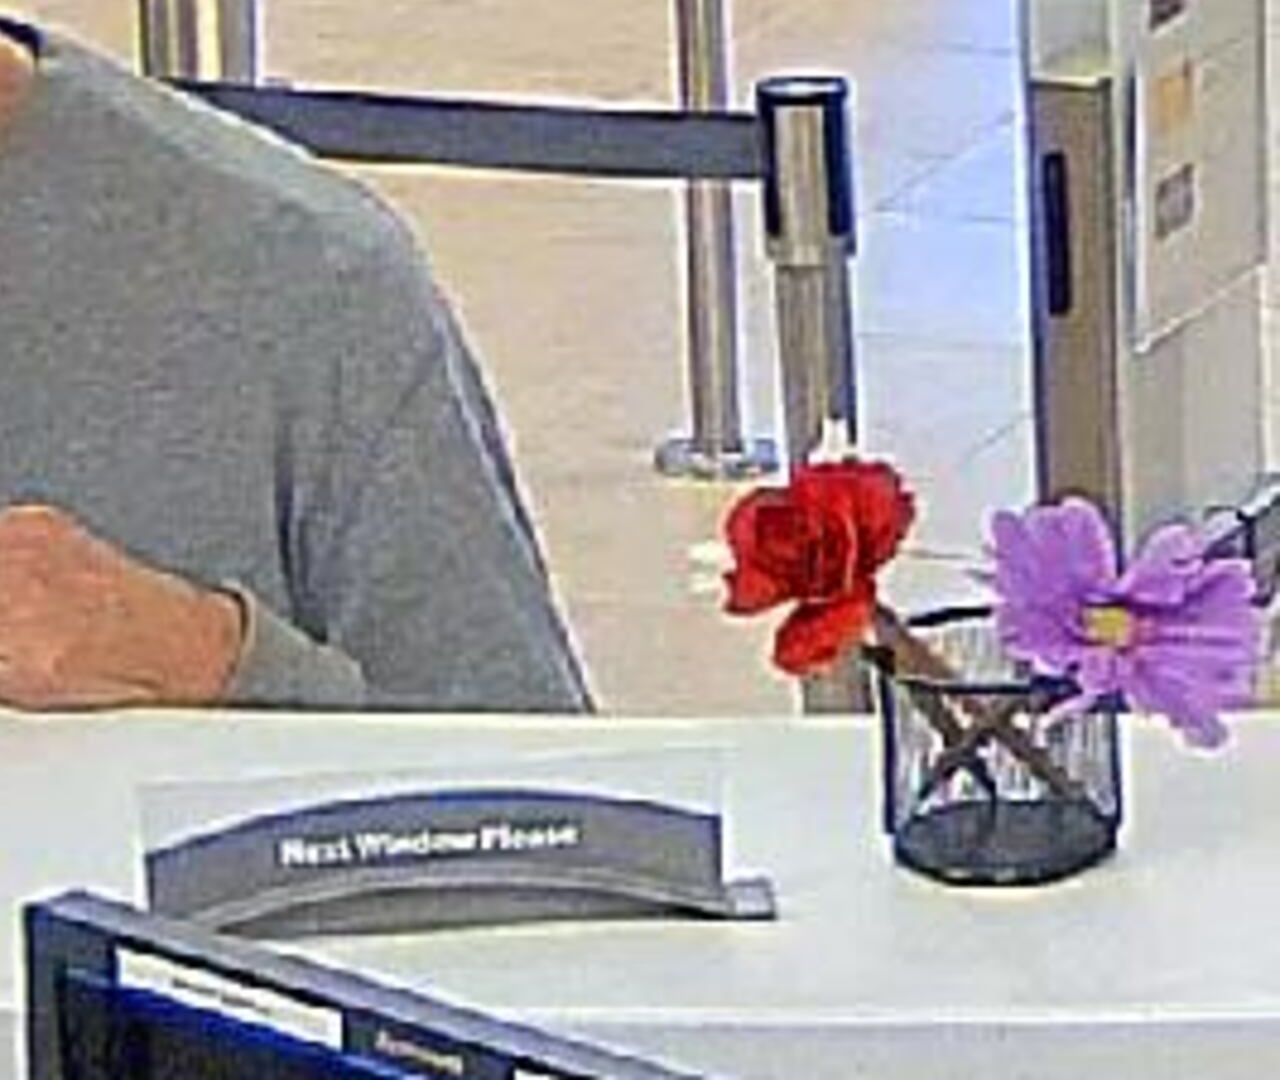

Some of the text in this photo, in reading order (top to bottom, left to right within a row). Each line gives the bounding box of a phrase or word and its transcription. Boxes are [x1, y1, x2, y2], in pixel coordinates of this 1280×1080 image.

[280, 823, 580, 865] Next Window Please
